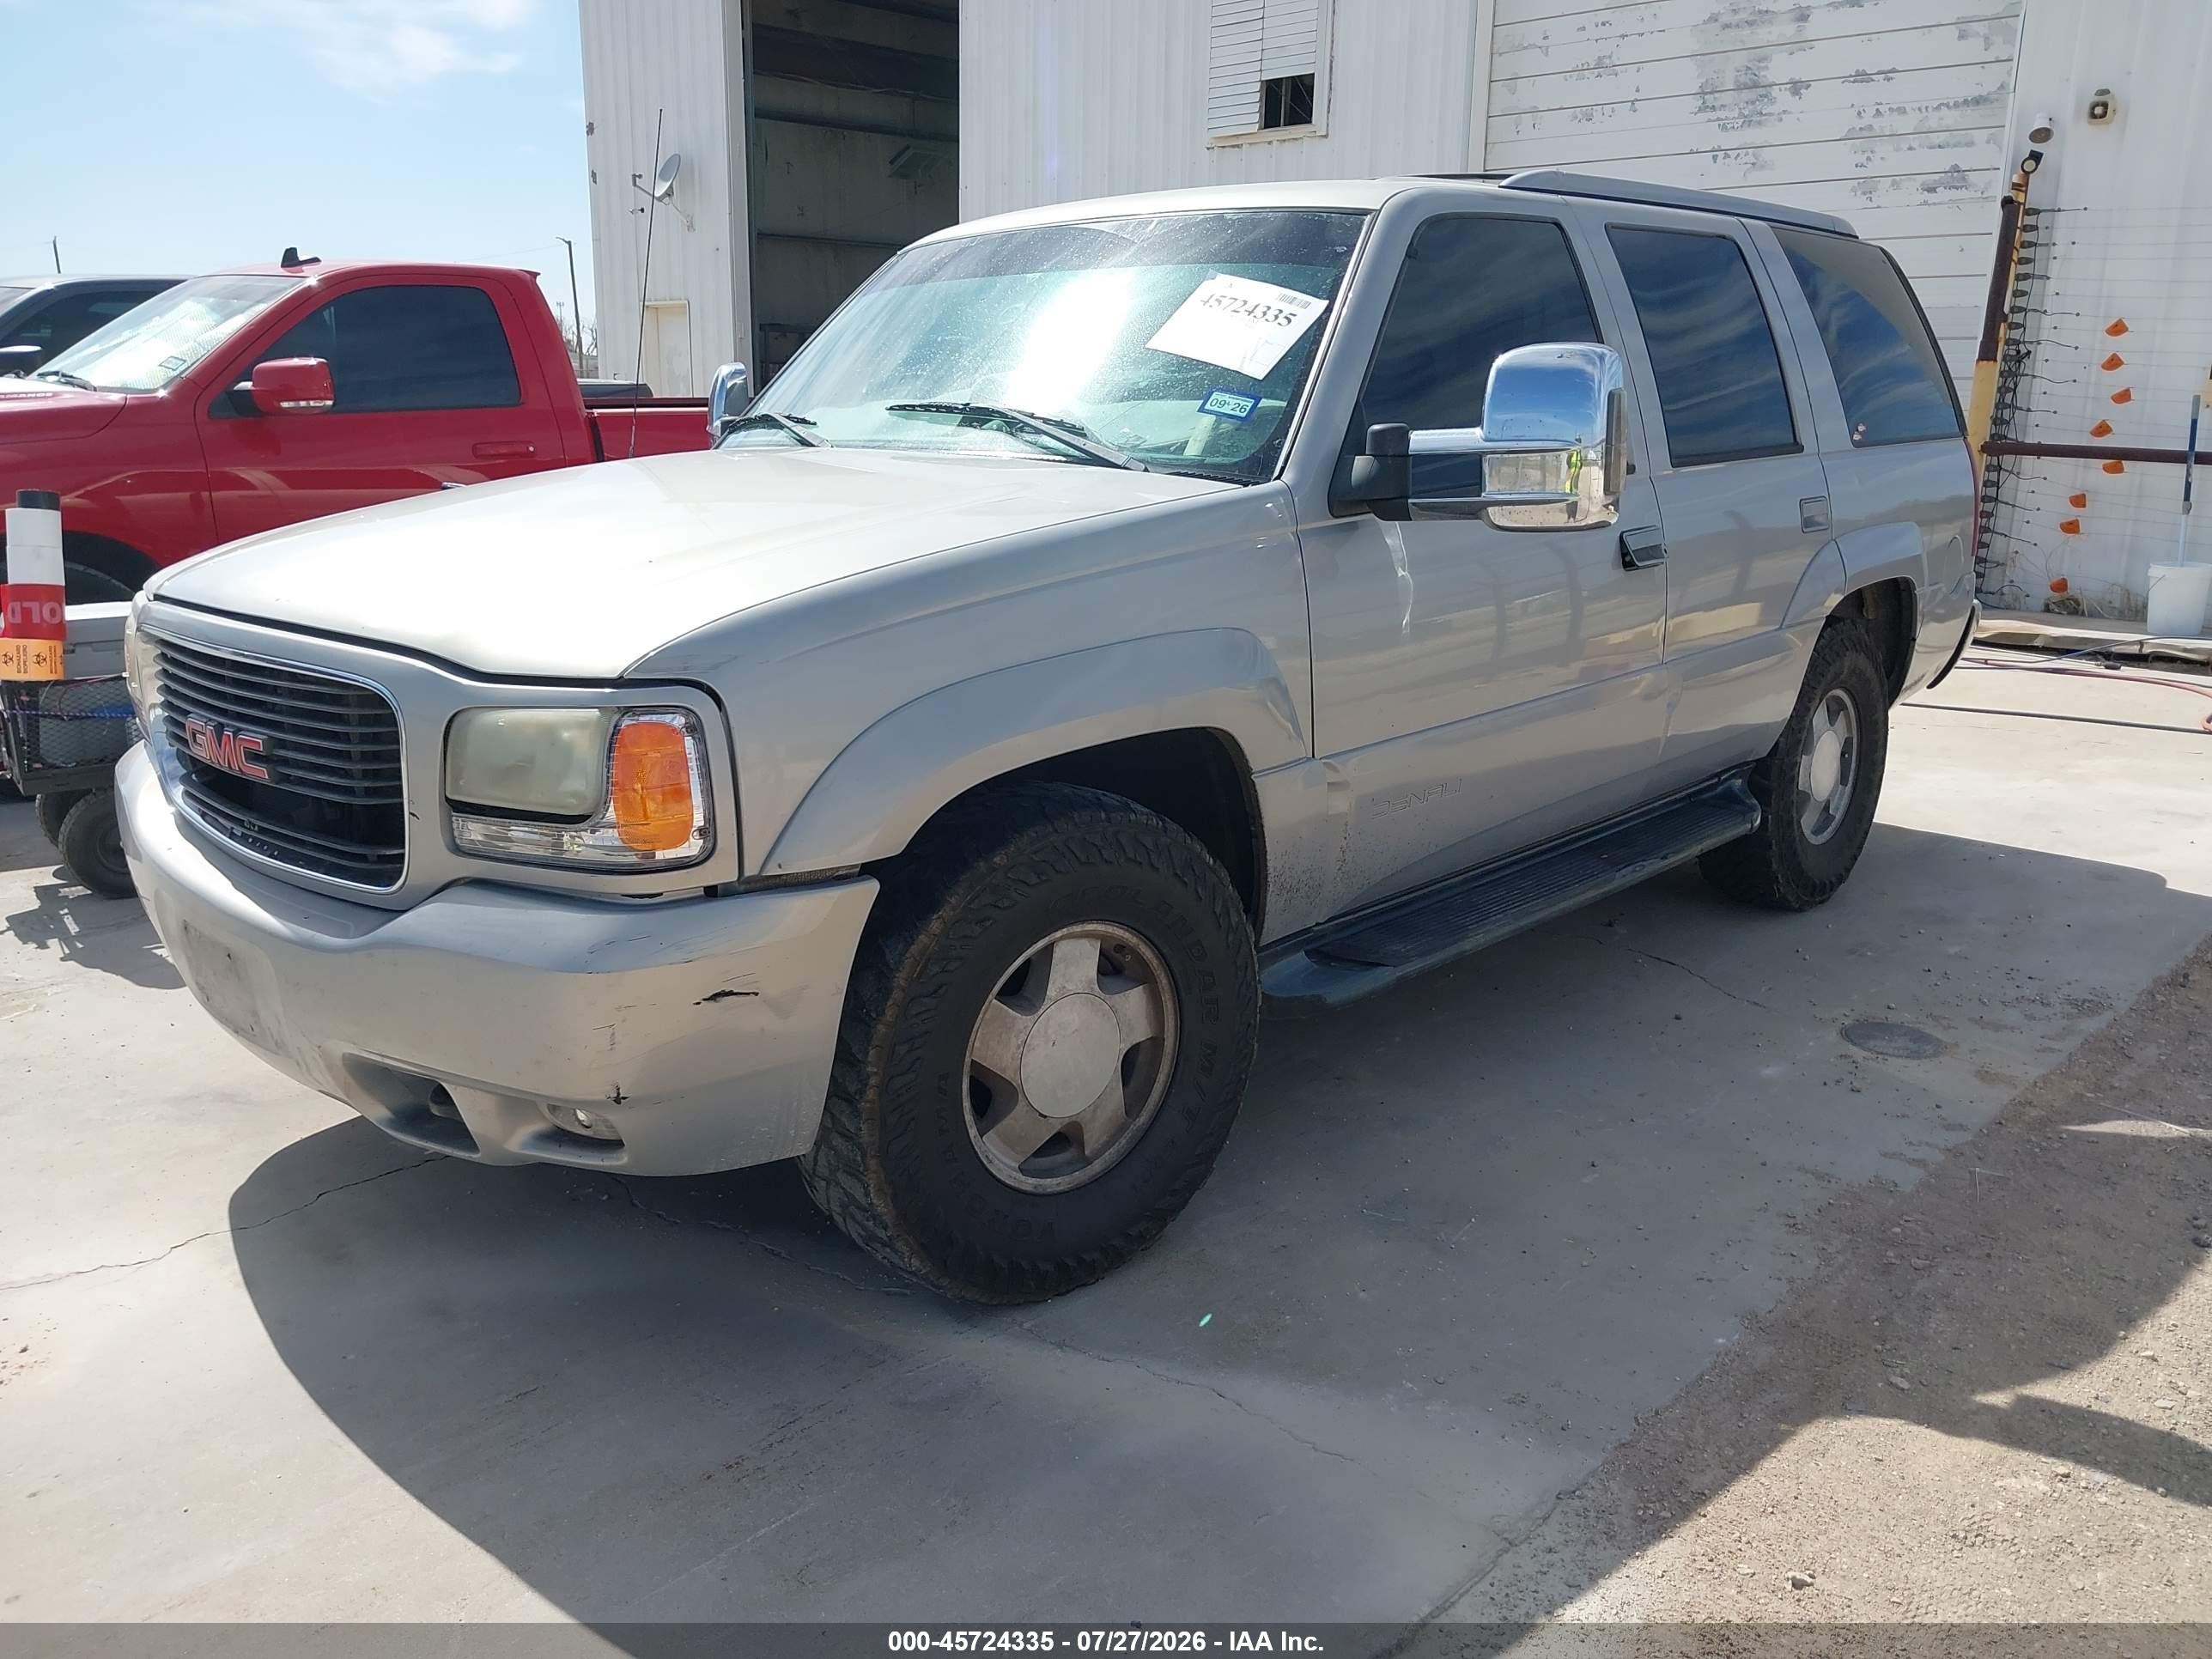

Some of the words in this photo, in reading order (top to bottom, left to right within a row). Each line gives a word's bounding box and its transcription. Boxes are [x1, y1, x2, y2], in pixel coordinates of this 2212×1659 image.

[1200, 292, 1297, 327] 45724335
[1209, 398, 1226, 409] 09
[1229, 402, 1249, 414] 26
[8, 601, 65, 624] OLD
[185, 715, 269, 780] GMC
[1370, 776, 1462, 820] DENALI
